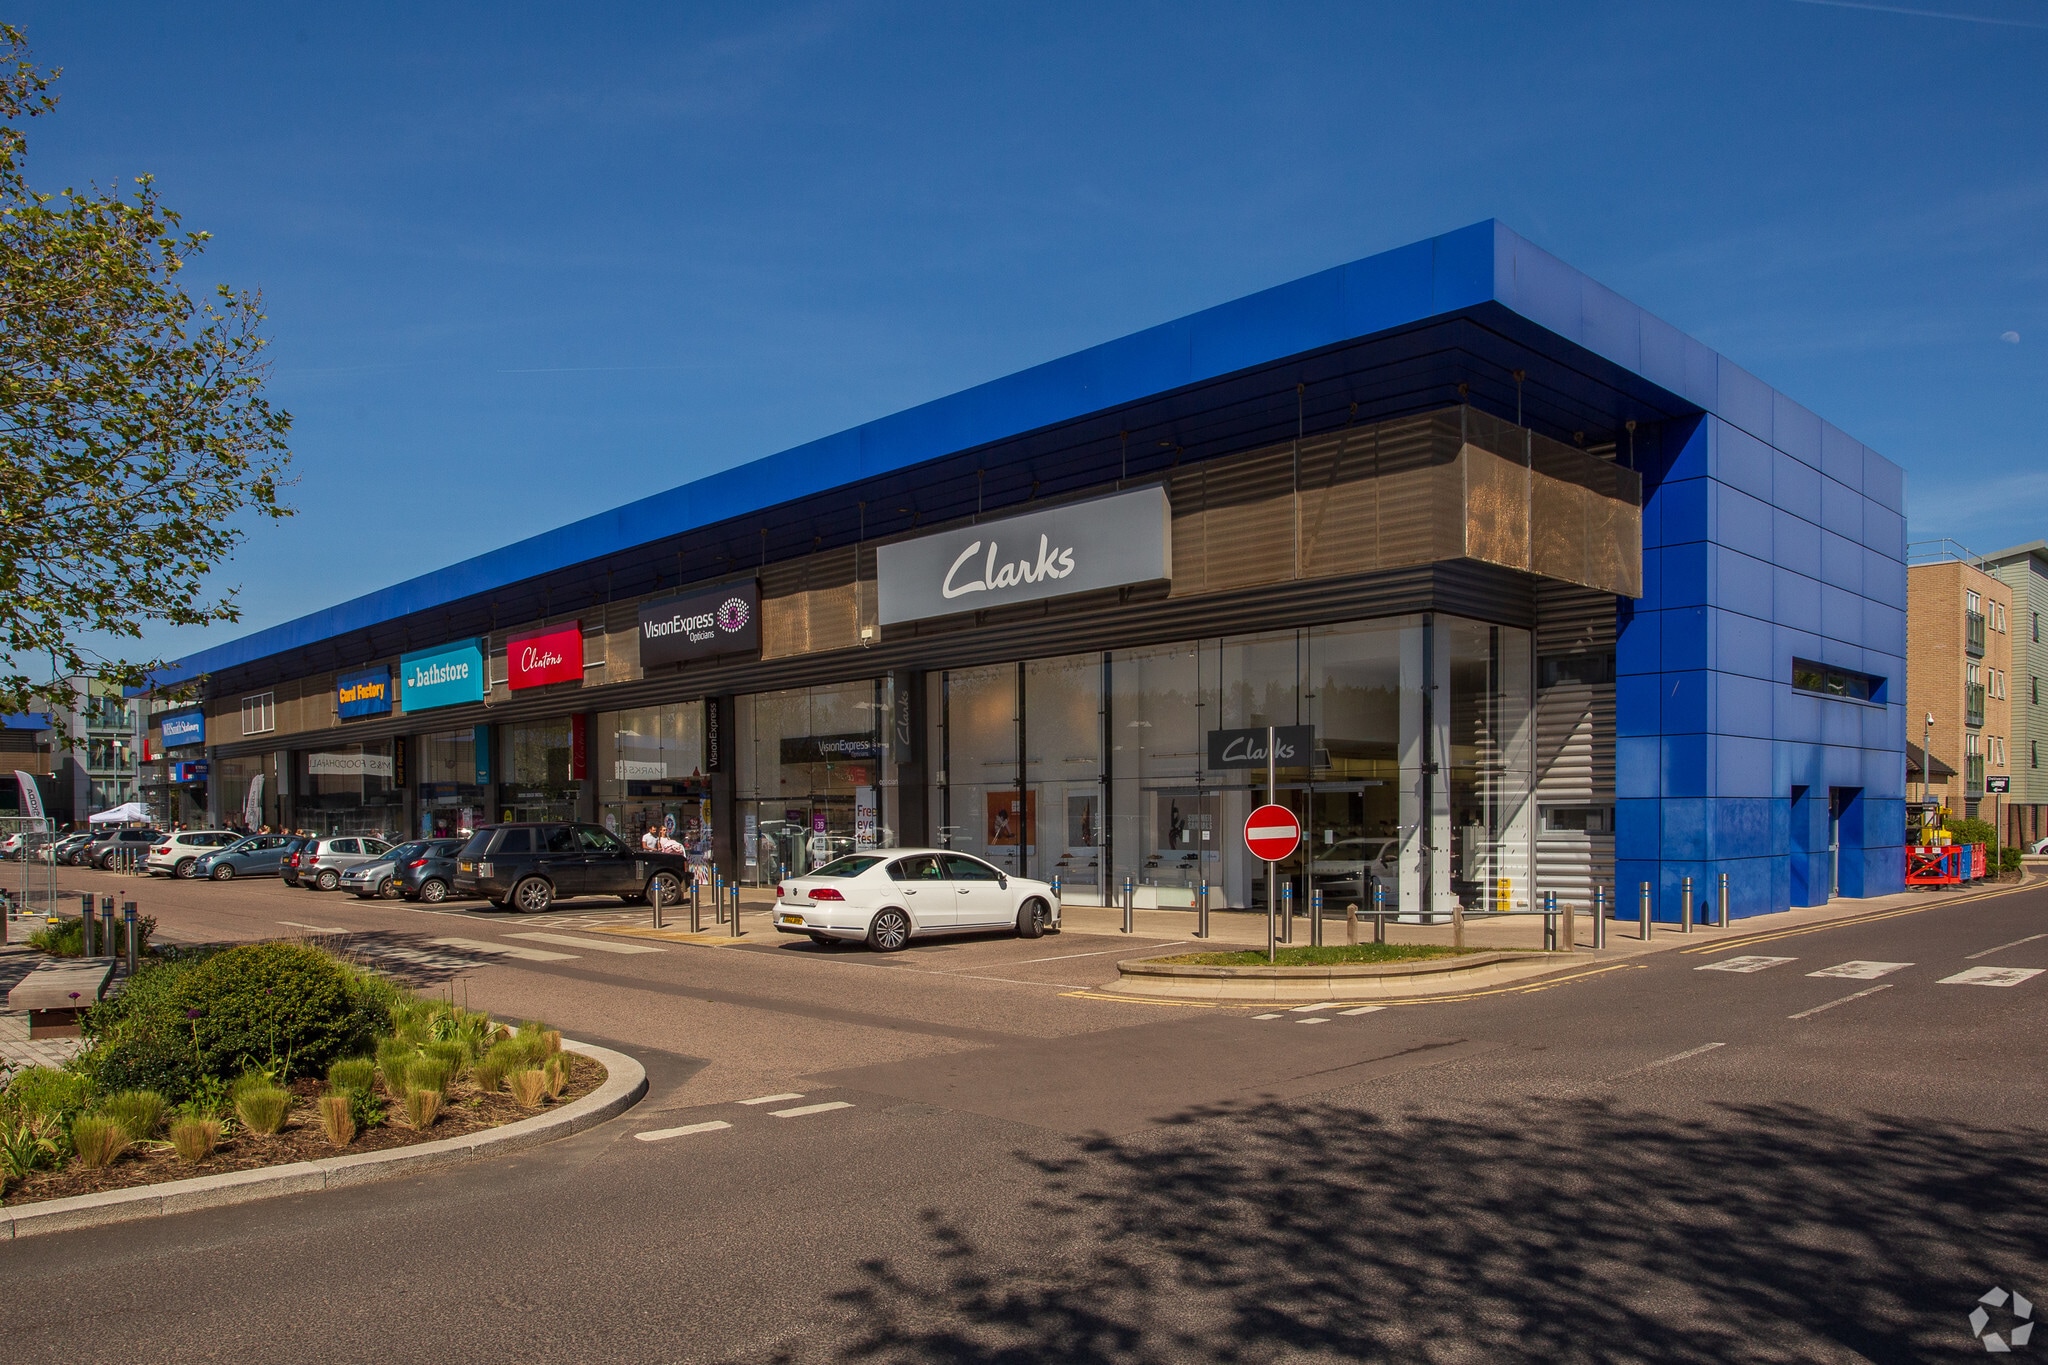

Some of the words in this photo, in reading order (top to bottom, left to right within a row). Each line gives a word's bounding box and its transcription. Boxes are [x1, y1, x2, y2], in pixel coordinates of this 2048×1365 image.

[942, 533, 1075, 599] Clarks
[644, 612, 714, 638] VisionExpress
[689, 630, 715, 643] Opticians
[521, 646, 563, 672] Clintons
[416, 662, 469, 687] bathstore
[339, 687, 356, 704] Card
[357, 682, 385, 700] Factory
[897, 690, 910, 745] Clarks
[708, 703, 718, 767] VisionExpress
[1222, 736, 1295, 761] Claks
[857, 804, 877, 817] Free
[857, 820, 875, 833] eye
[857, 833, 877, 845] test
